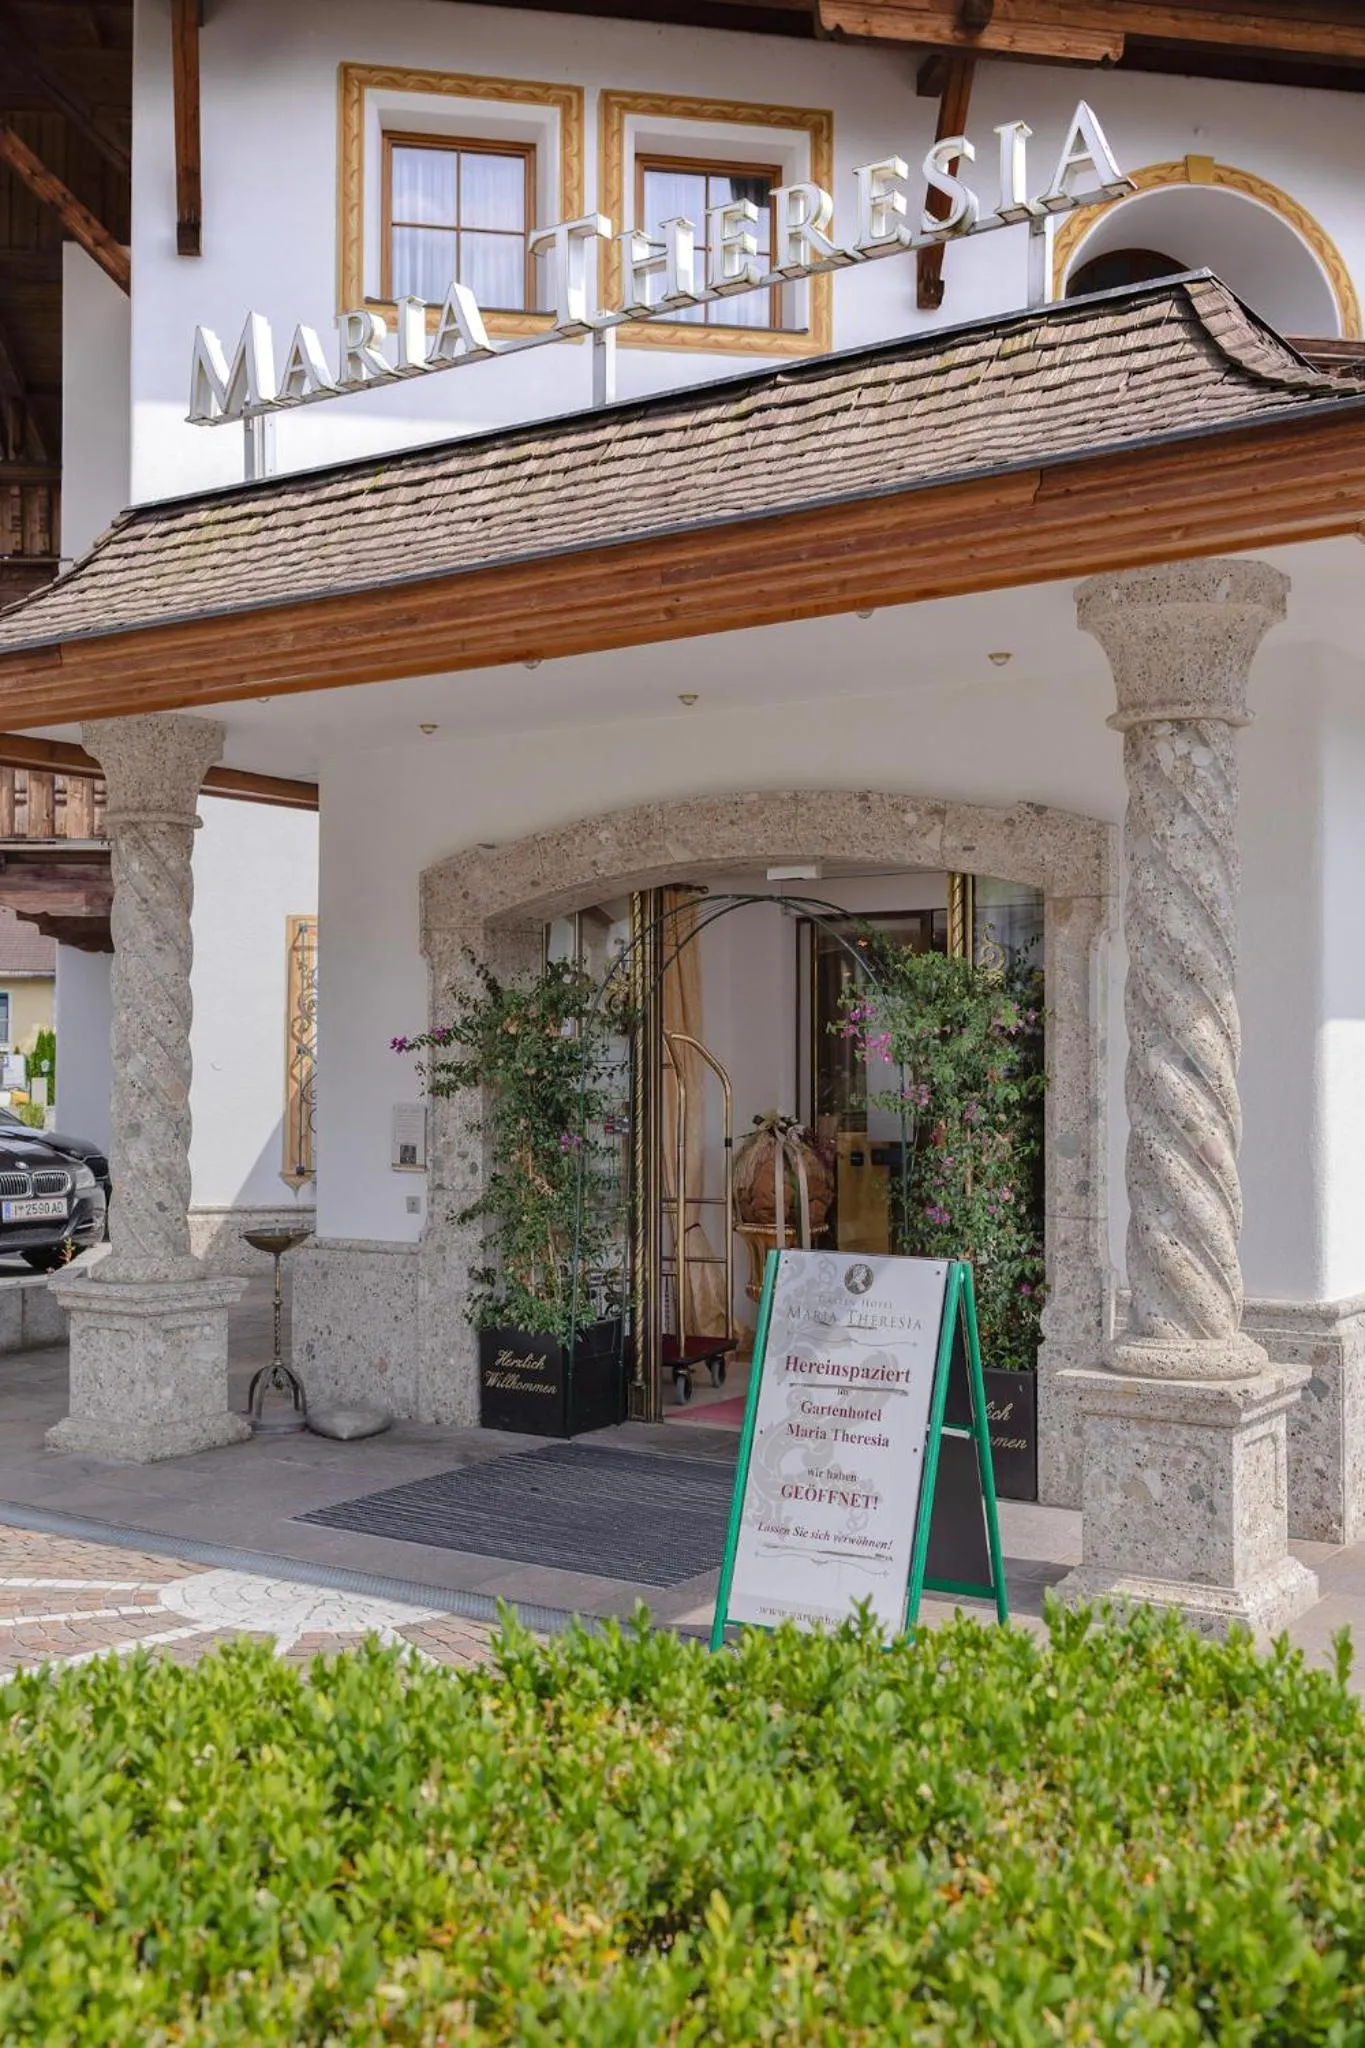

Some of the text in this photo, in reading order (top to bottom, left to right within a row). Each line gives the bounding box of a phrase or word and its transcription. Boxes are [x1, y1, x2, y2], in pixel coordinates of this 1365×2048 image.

[185, 100, 1138, 426] MARIA THERESIA
[787, 1305, 922, 1331] MARIA THERESIA
[495, 1349, 547, 1370] Herzlich
[784, 1355, 911, 1384] Hereinspaziert
[485, 1370, 558, 1394] Willkommen
[800, 1400, 882, 1421] Gartenhotel
[786, 1423, 890, 1448] Maria Theresia
[826, 1468, 857, 1482] haben
[781, 1483, 879, 1510] GEÖFFNET!
[757, 1521, 894, 1551] Lassen Sie sich verwöhnen!
